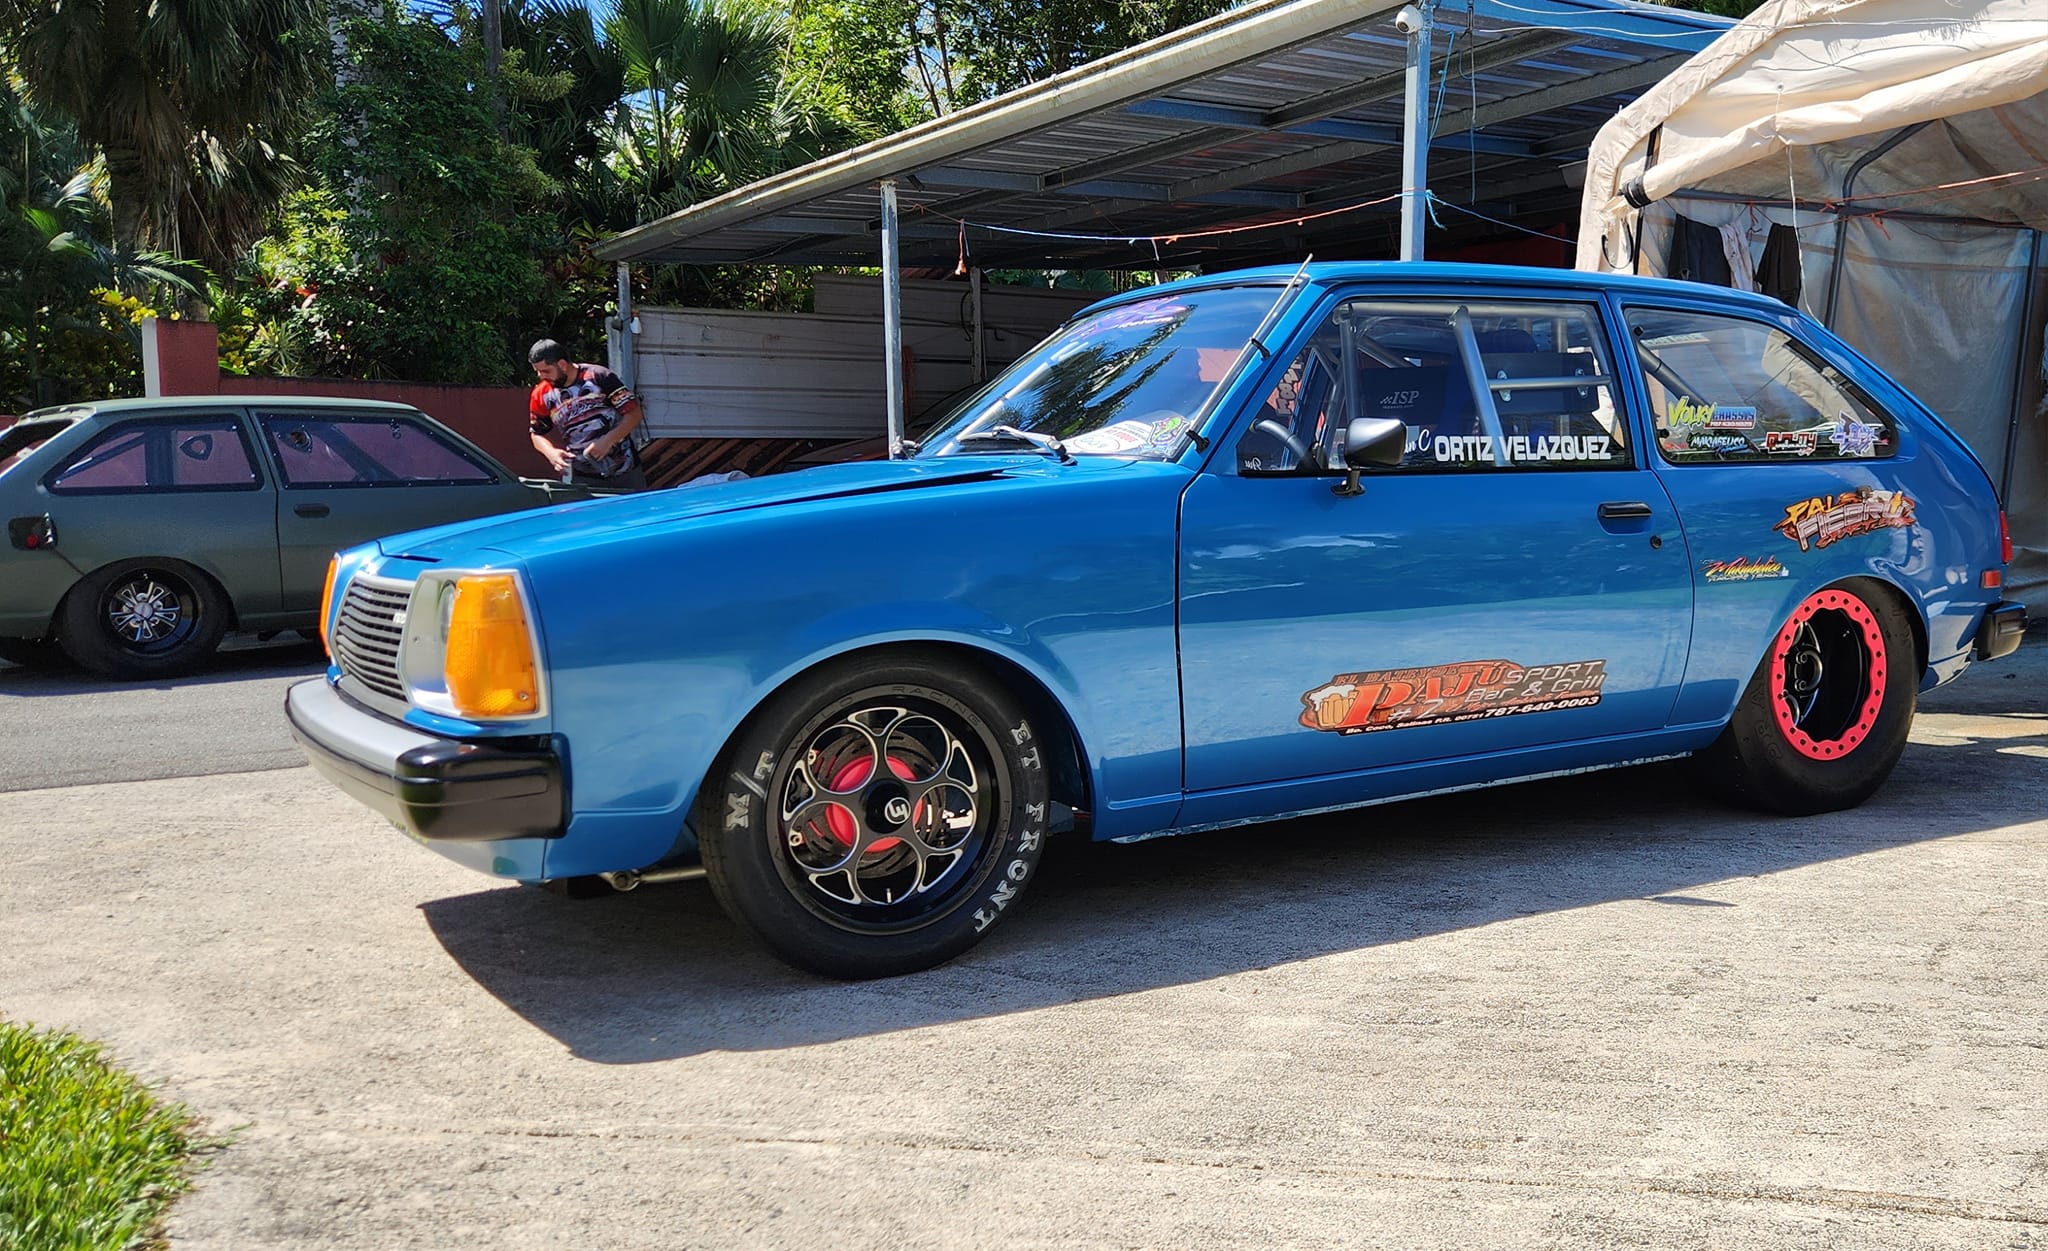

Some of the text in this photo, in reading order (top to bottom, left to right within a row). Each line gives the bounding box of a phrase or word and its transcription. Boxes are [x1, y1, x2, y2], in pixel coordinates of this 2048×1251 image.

[1391, 390, 1420, 405] ISP
[1418, 428, 1432, 452] C
[1435, 435, 1494, 462] ORTIZ
[1498, 435, 1612, 461] VELAZQUEZ
[1785, 496, 1845, 525] PAL
[1464, 687, 1515, 702] Bar
[1521, 681, 1543, 696] &
[1551, 673, 1606, 692] Grill
[1503, 661, 1603, 685] SPORT
[1484, 696, 1600, 718] 787-640-0003
[1396, 719, 1433, 728] Salinas
[726, 749, 776, 831] M/T
[972, 719, 1046, 934] ET FRONT
